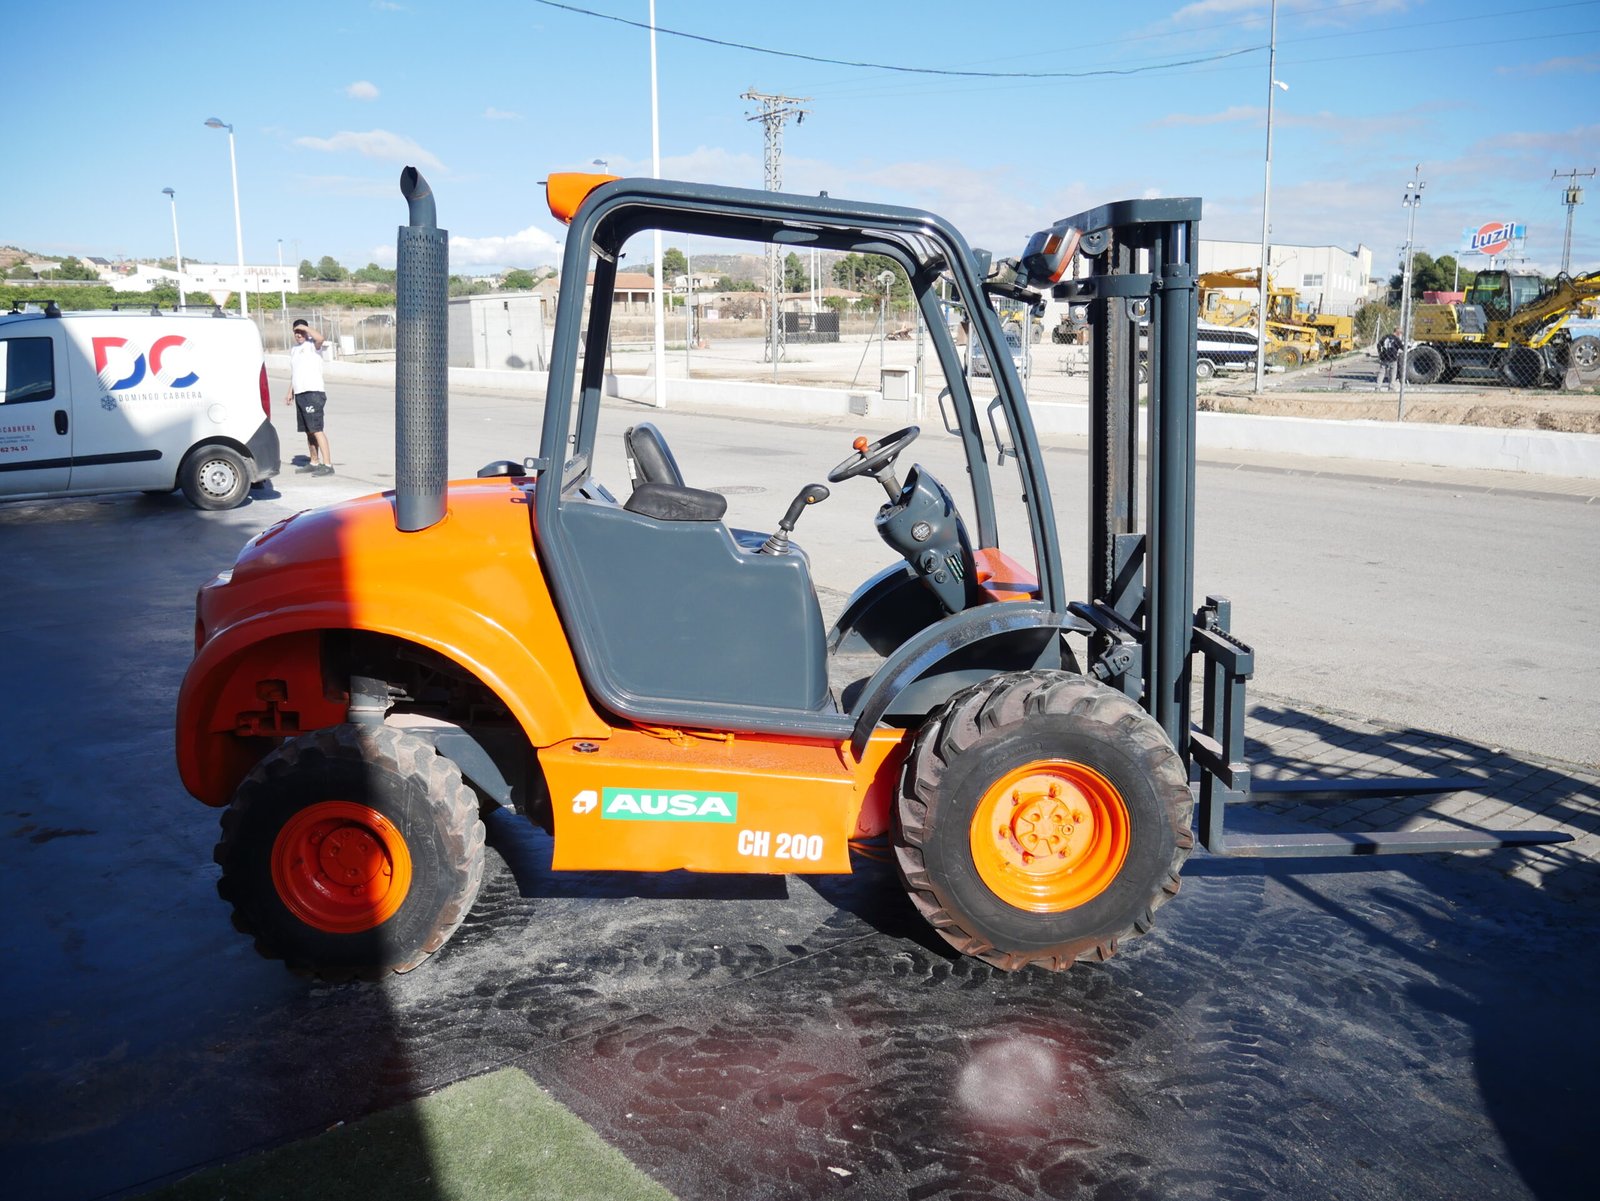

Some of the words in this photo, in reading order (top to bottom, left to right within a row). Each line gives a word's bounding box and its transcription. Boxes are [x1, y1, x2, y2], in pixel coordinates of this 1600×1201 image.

[1471, 223, 1515, 249] Luzil
[118, 392, 159, 402] DOMINGO
[163, 391, 203, 400] CABRERA
[606, 794, 732, 817] AUSA
[738, 830, 769, 857] CH
[775, 834, 823, 861] 200
